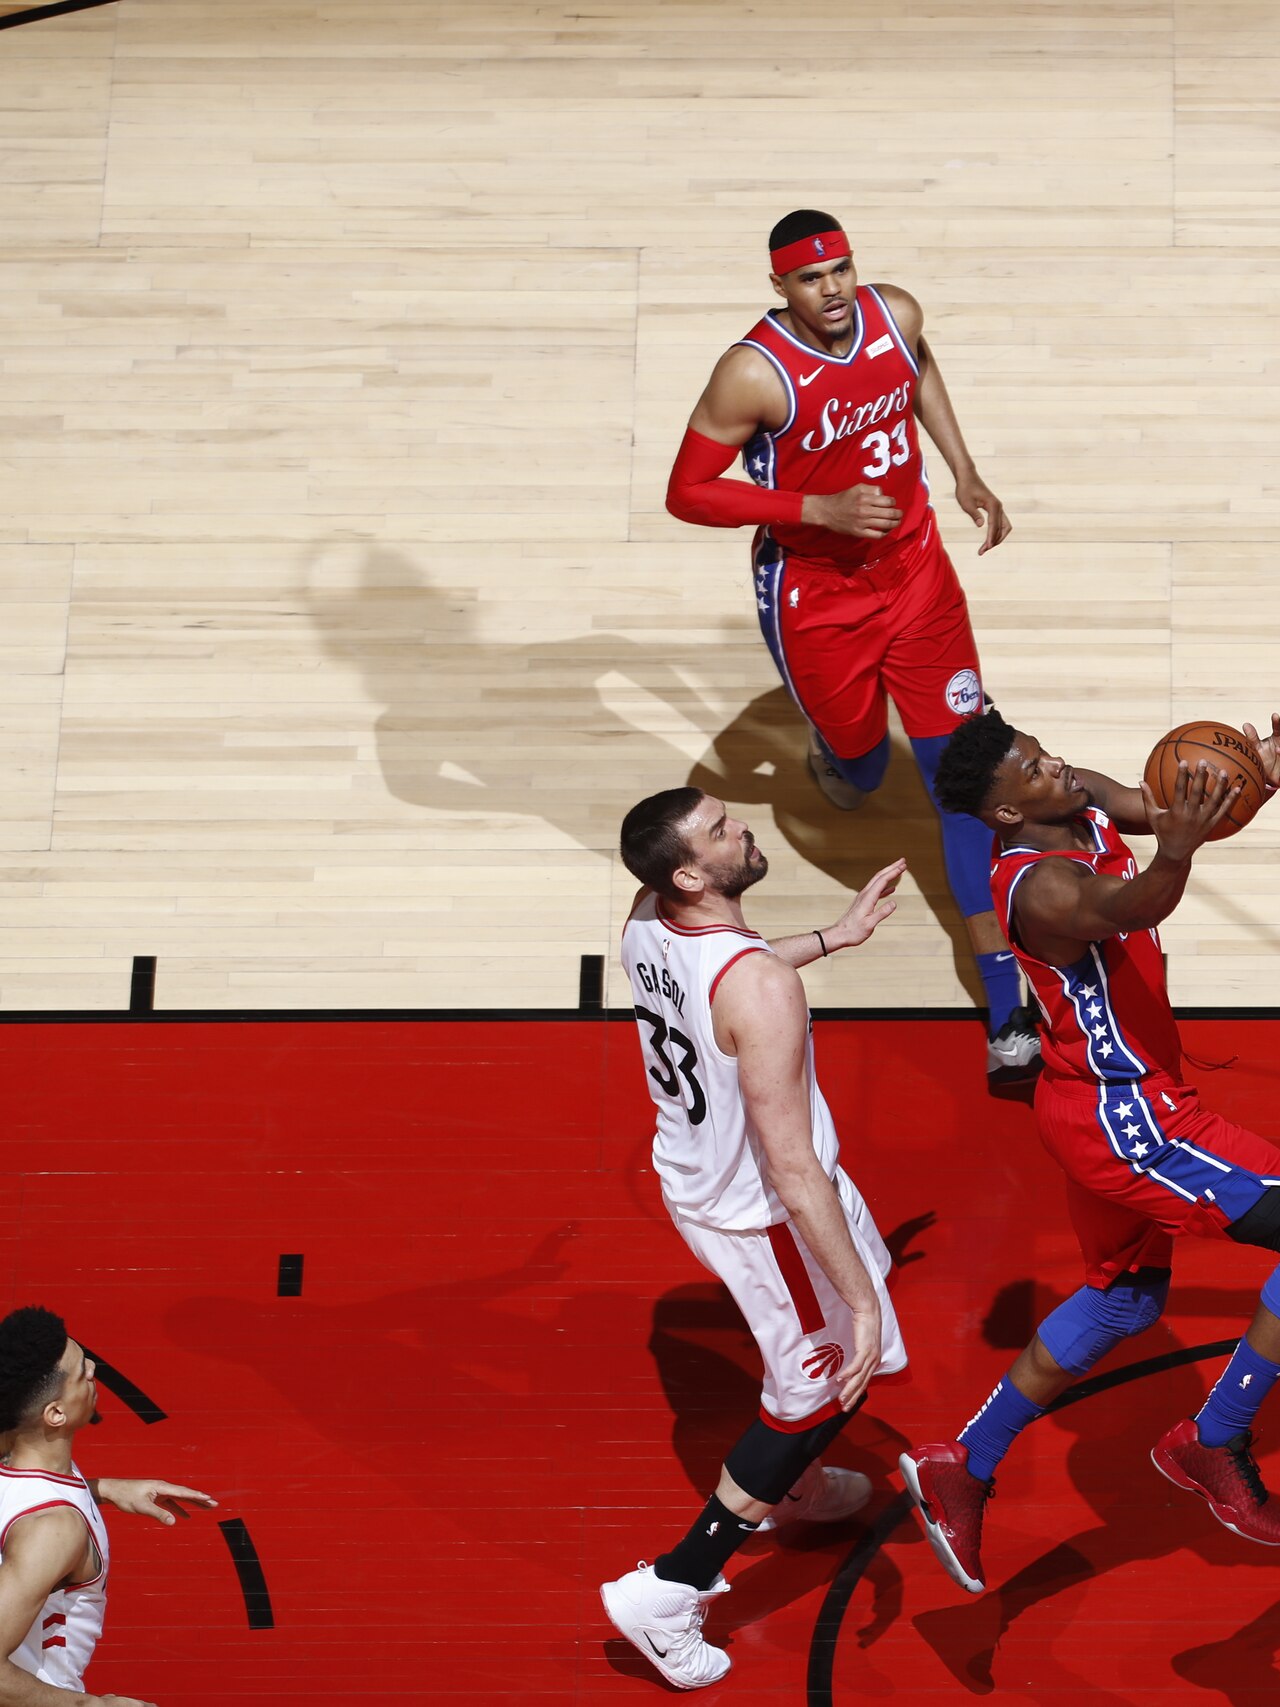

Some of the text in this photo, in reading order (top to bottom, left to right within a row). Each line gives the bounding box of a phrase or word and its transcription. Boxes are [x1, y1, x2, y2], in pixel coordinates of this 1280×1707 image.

[801, 381, 910, 451] Sixers
[861, 419, 910, 479] 33
[637, 962, 686, 1020] GASOL
[634, 1004, 707, 1126] 33
